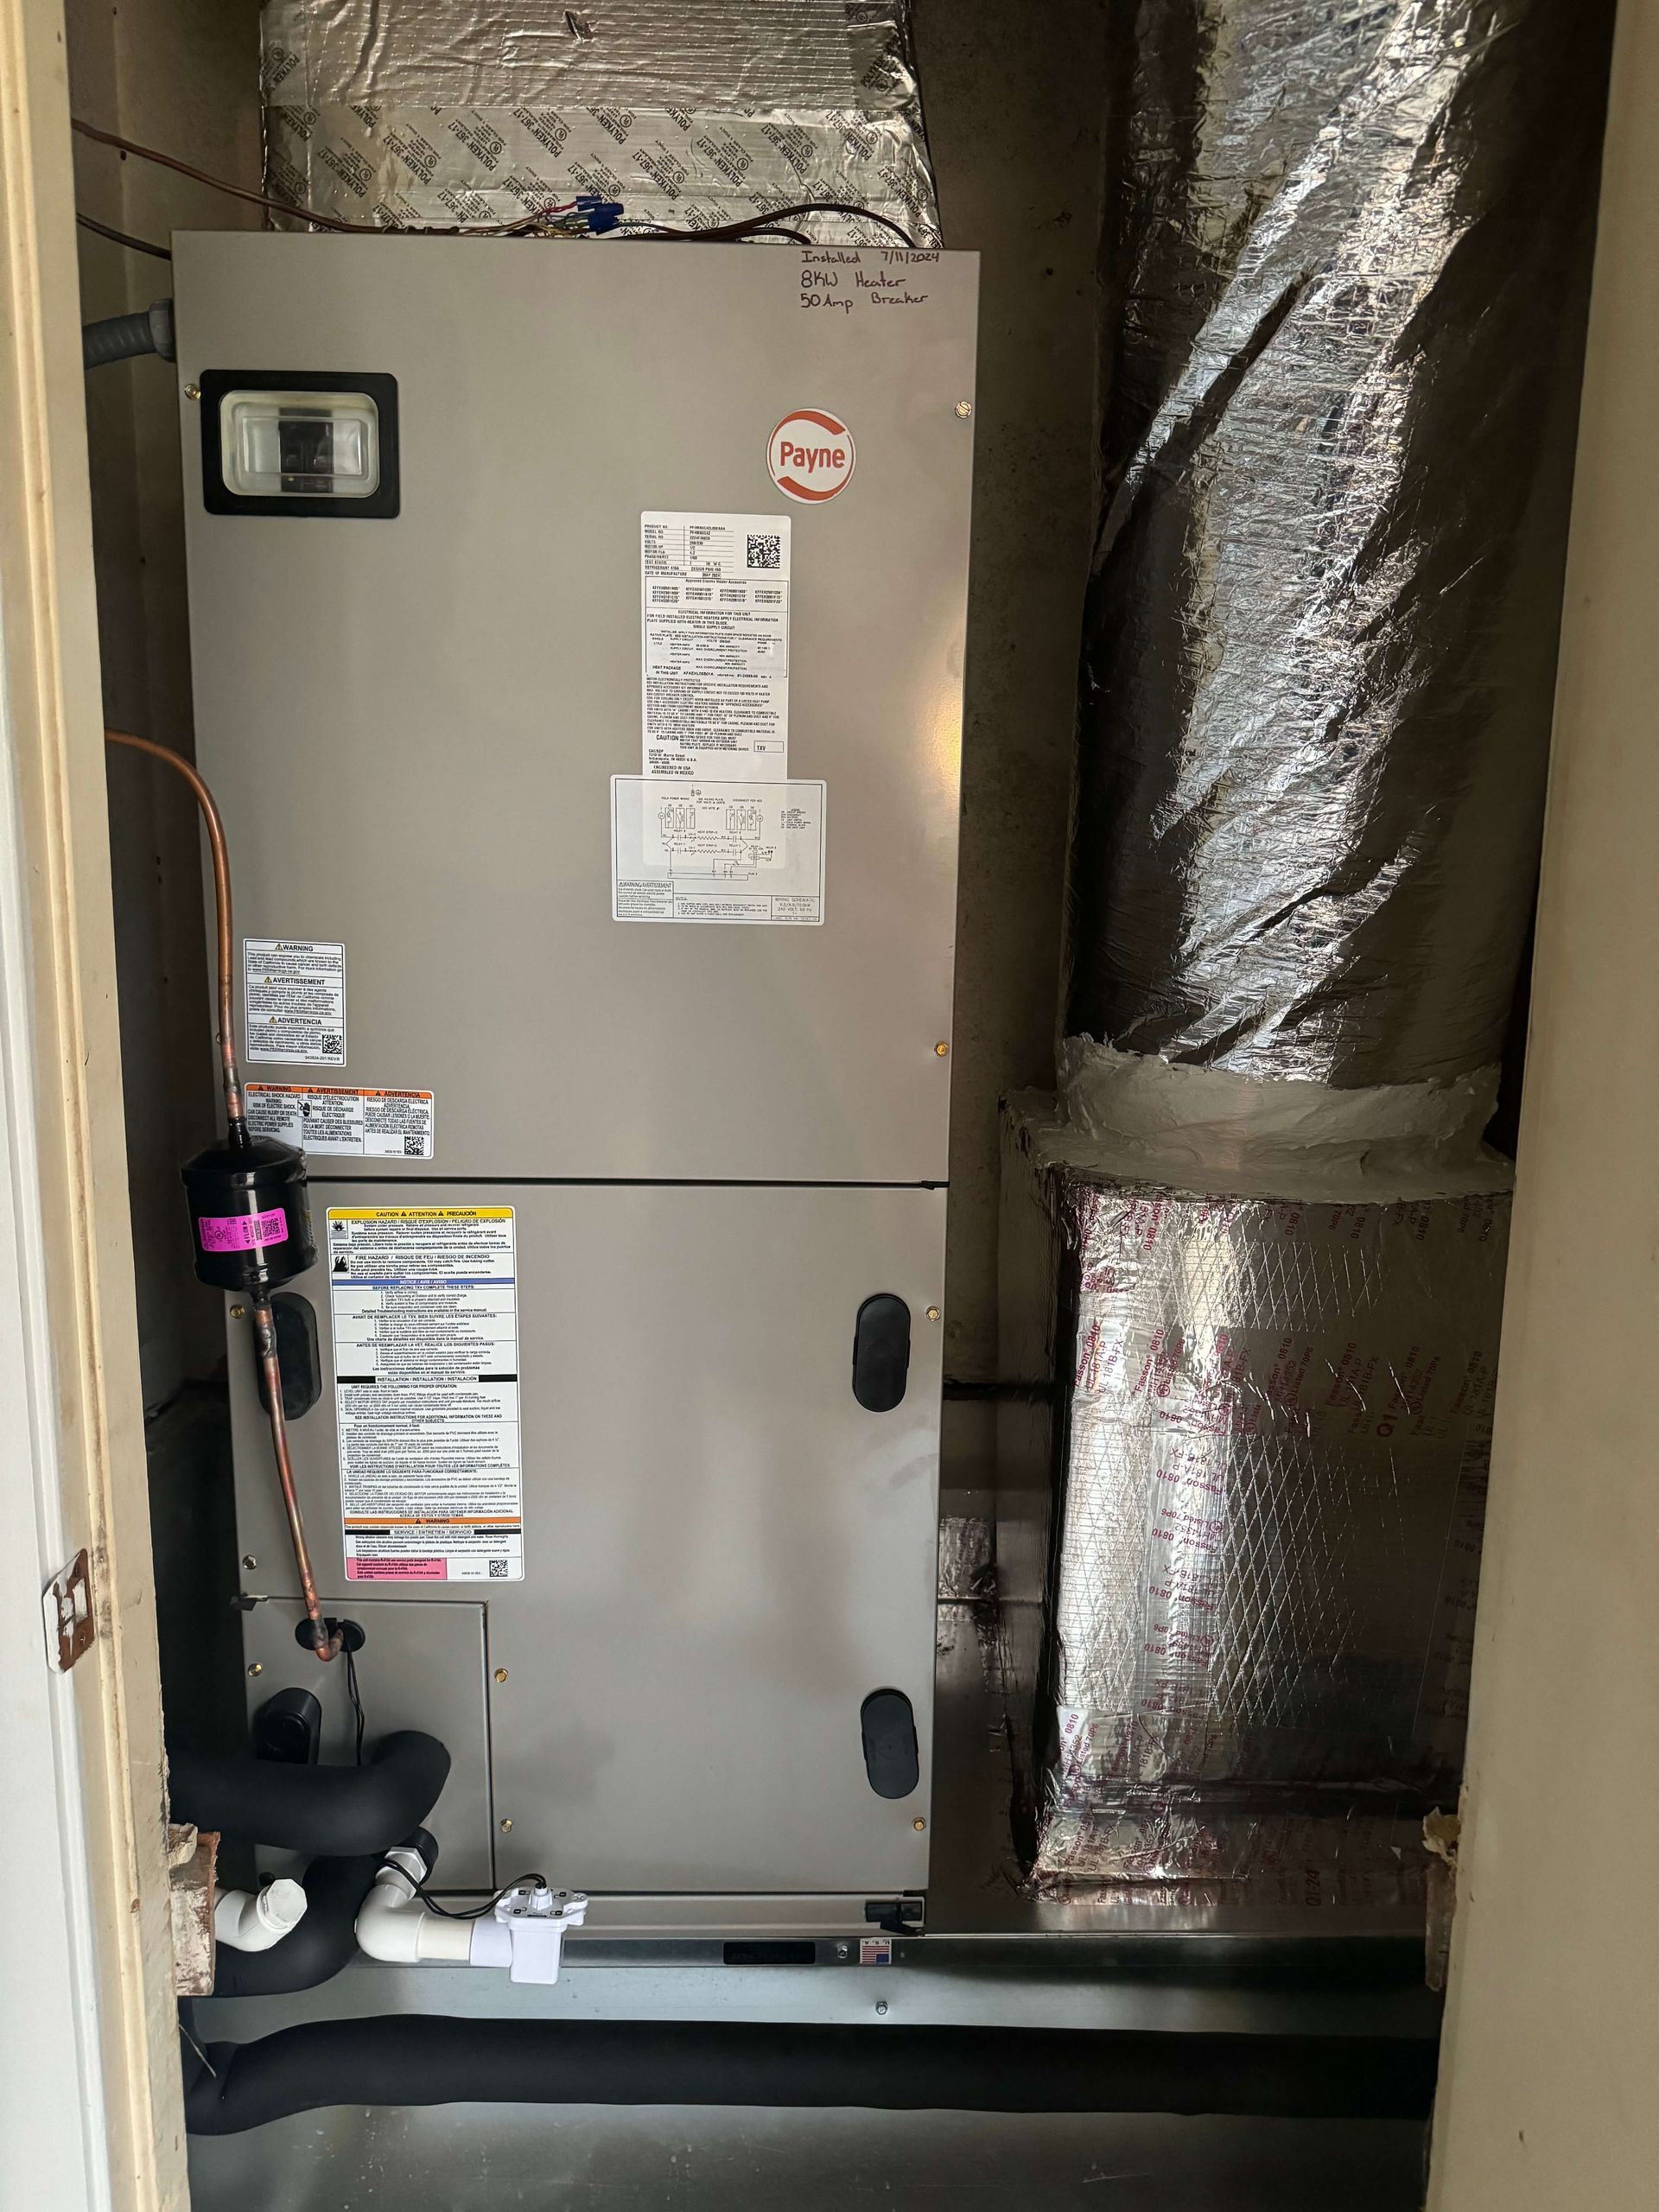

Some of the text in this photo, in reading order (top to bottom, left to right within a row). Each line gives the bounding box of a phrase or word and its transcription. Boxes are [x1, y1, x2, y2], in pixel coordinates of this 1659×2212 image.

[801, 251, 940, 264] Installed 7/11/2024
[856, 271, 906, 288] Heater
[800, 292, 929, 314] 50 Amp Breaker
[779, 442, 846, 474] Payne
[1156, 1469, 1179, 1483] 0810
[1151, 1529, 1174, 1541] 0810
[1148, 1586, 1173, 1599] 0810
[1144, 1643, 1166, 1656] 0810
[1065, 1713, 1079, 1734] 0810
